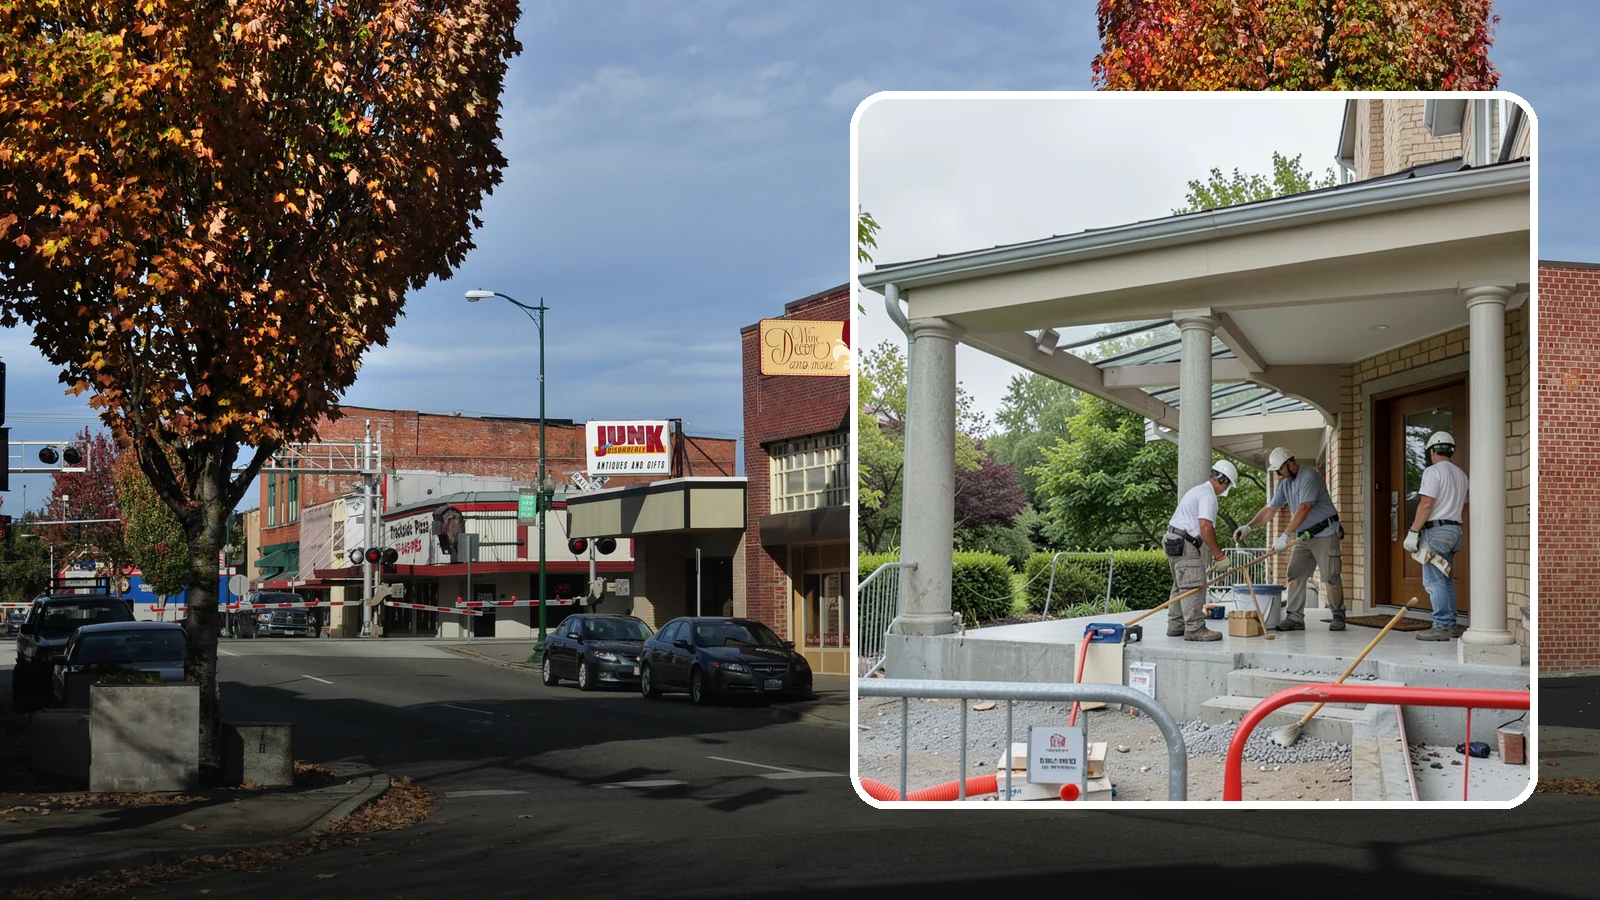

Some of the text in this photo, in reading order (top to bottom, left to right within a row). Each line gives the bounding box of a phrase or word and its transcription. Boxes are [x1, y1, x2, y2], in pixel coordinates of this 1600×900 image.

[595, 425, 665, 457] JUNK
[607, 446, 646, 454] DISORDERLY
[597, 460, 665, 470] ANTIQUES AND GIFTS
[414, 519, 429, 535] Pizza
